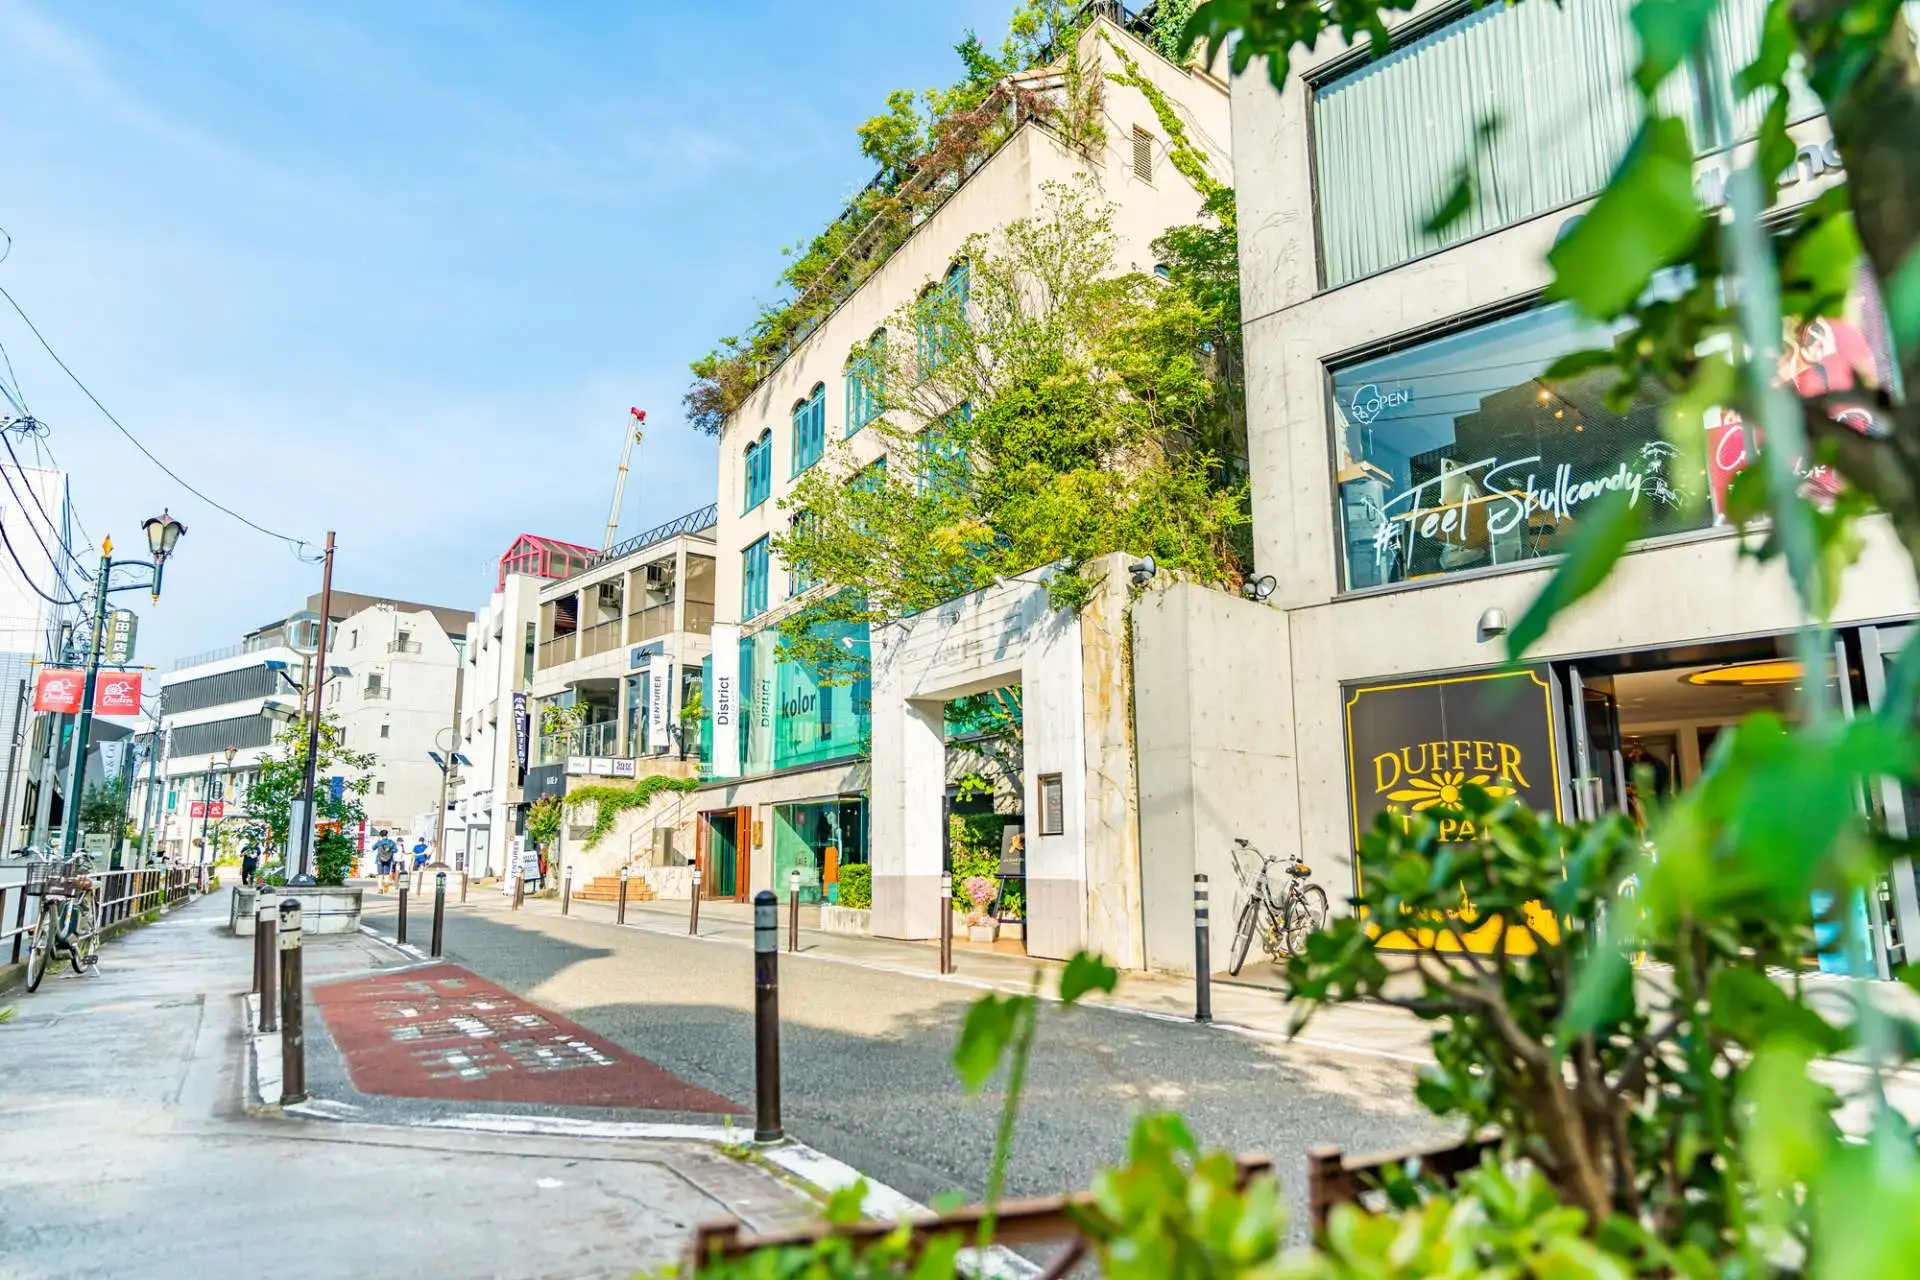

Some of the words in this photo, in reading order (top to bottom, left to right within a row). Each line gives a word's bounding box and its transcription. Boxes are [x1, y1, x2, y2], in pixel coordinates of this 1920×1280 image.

[1367, 390, 1408, 412] OPEN
[1484, 455, 1643, 534] Skullcandy
[717, 677, 730, 725] District
[782, 686, 816, 719] kolor
[1372, 740, 1531, 794] DUFFER
